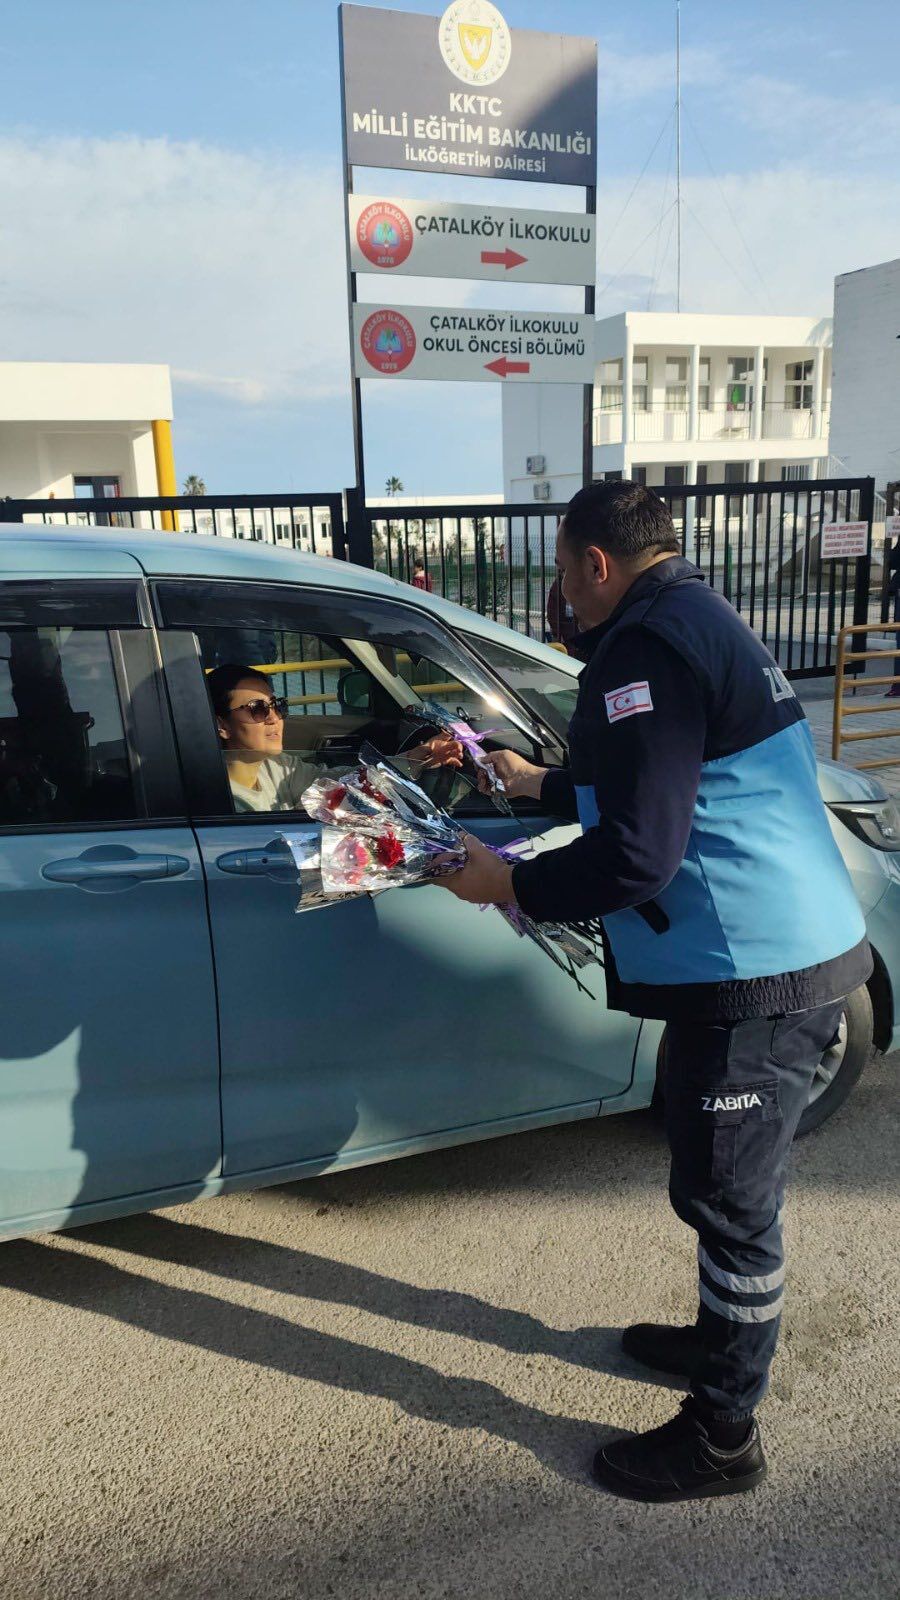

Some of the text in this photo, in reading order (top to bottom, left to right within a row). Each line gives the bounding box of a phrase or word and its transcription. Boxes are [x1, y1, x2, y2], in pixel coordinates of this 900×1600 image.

[450, 93, 502, 117] KKTC
[353, 109, 591, 155] MİLLİ EĞİTİM BAKANLIĞI
[405, 144, 546, 173] İLKÖĞRETİM DAİRESİ
[415, 215, 591, 244] ÇATALKÖY İLKOKULU
[430, 314, 579, 335] ÇATALKÖY İLKOKULU
[423, 335, 585, 356] OKUL ÖNCESİ BÖLÜMÜ
[701, 1093, 762, 1112] ZABITA
